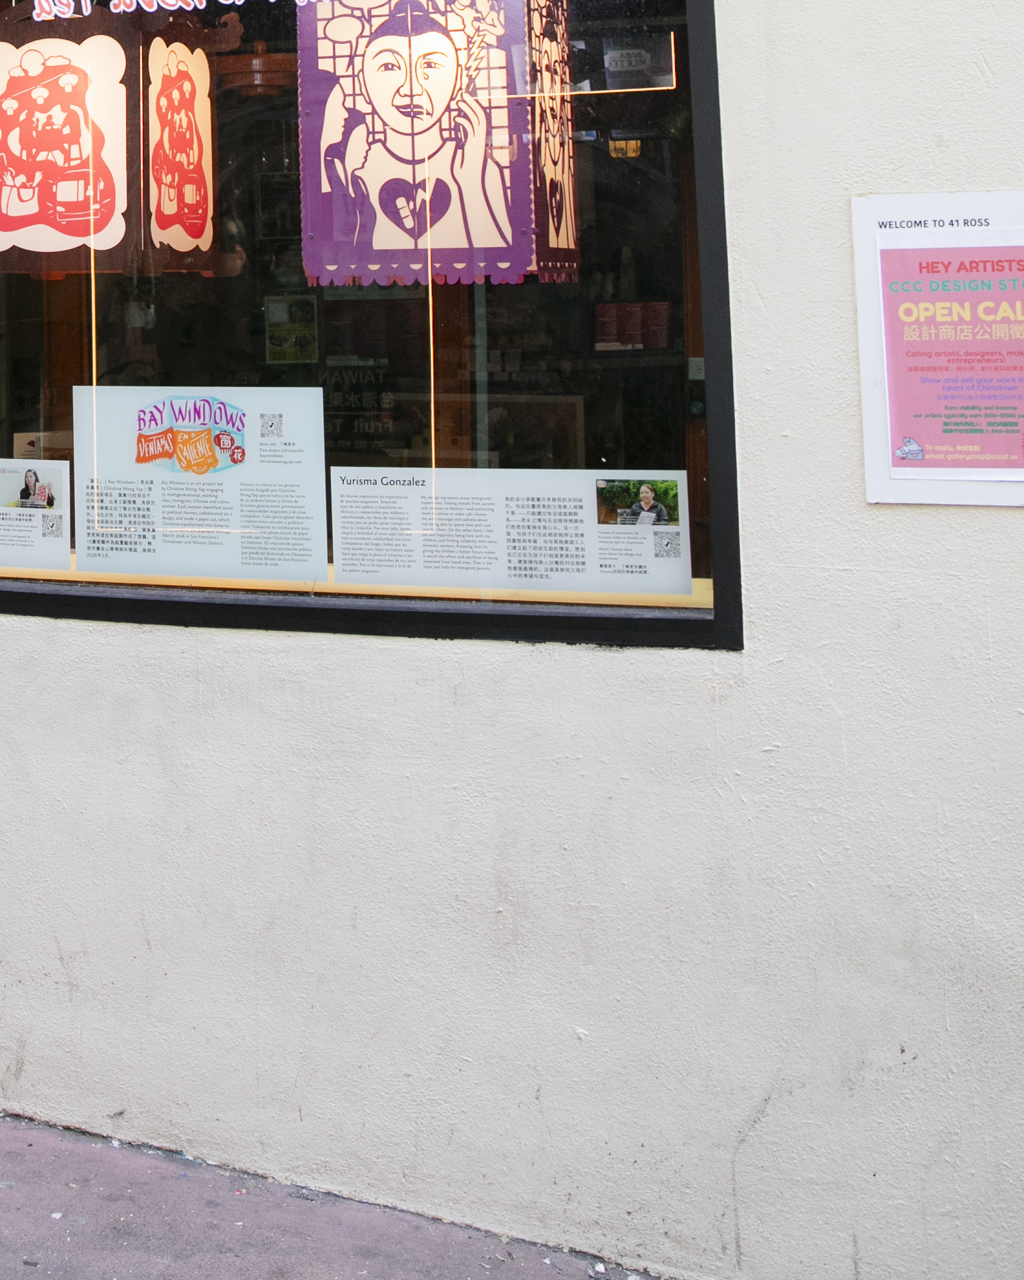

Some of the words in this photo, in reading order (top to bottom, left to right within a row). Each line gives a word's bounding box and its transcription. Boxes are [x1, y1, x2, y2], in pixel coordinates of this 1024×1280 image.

[878, 220, 929, 229] WELCOME
[932, 219, 945, 228] TO
[964, 218, 990, 227] ROSS
[919, 261, 952, 274] HEY
[956, 259, 1024, 273] ARTISTS
[889, 281, 923, 293] CCC
[930, 279, 992, 292] DESIGN
[999, 279, 1024, 291] ST
[898, 301, 971, 323] OPEN
[137, 400, 165, 431] BAY
[178, 433, 188, 442] EN
[139, 433, 173, 458] VENTANAS
[177, 431, 212, 467] SALIENTE
[340, 476, 377, 486] Yurisma
[380, 476, 426, 486] Gonzalez
